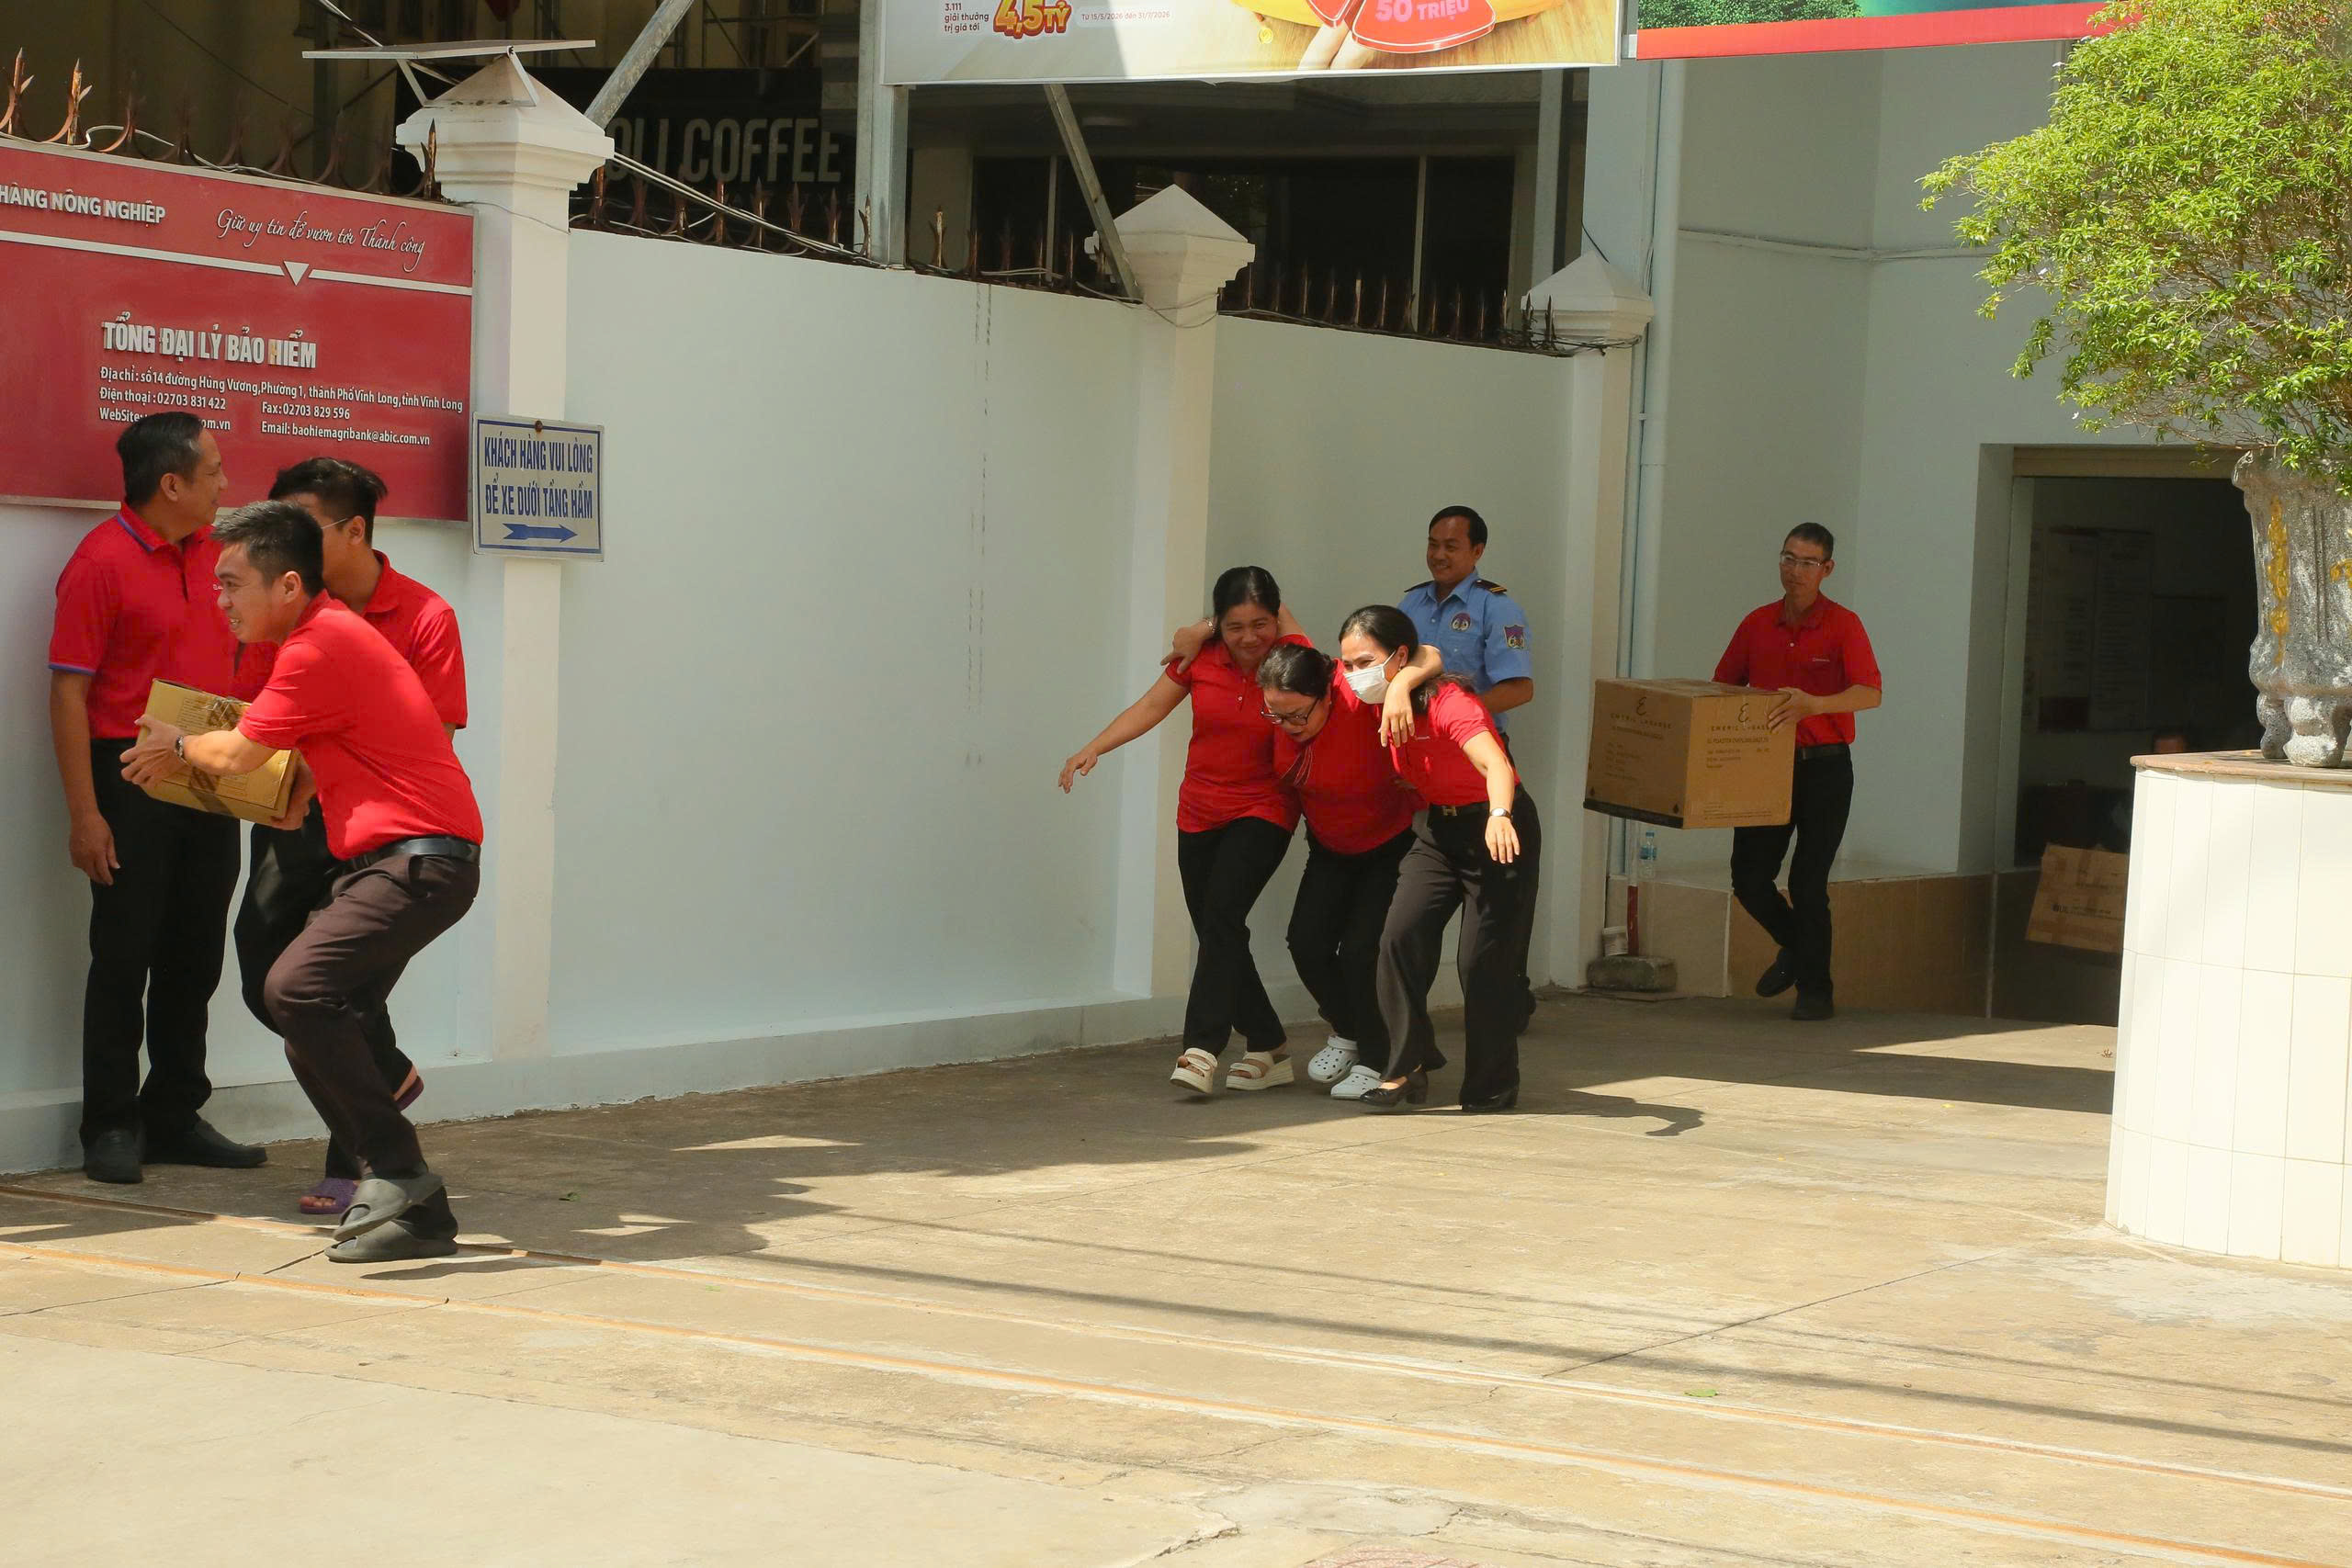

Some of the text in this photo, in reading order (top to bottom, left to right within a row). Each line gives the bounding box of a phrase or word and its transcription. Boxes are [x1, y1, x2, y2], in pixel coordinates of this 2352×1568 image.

[944, 3, 962, 11] 3.111
[1375, 0, 1412, 22] 50
[681, 118, 842, 183] COFFEE
[50, 188, 101, 217] NÔNG
[103, 199, 166, 228] NGHIỆP
[217, 209, 425, 272] Giữ uy tín để vươn tới Thành công
[101, 310, 316, 368] TỔNG ĐẠI LÝ BẢO HIỂM
[100, 387, 122, 403] Điện
[190, 396, 206, 408] 831
[208, 397, 226, 410] 422
[164, 371, 197, 390] đường
[198, 375, 225, 393] Hùng
[309, 385, 336, 400] thành
[337, 384, 354, 401] Phố
[355, 389, 374, 403] Vĩnh
[420, 395, 440, 409] Vĩnh
[441, 398, 463, 412] Long
[313, 406, 331, 419] 829
[333, 407, 350, 420] 596
[262, 421, 430, 446] Email: baohiemagribank@abic.com.vn
[484, 431, 594, 473] KHÁCH HÀNG VUI LÒNG
[485, 472, 499, 514] ĐỂ
[502, 485, 514, 515] XE
[517, 479, 541, 516] DƯỚI
[543, 479, 569, 517] TẦNG
